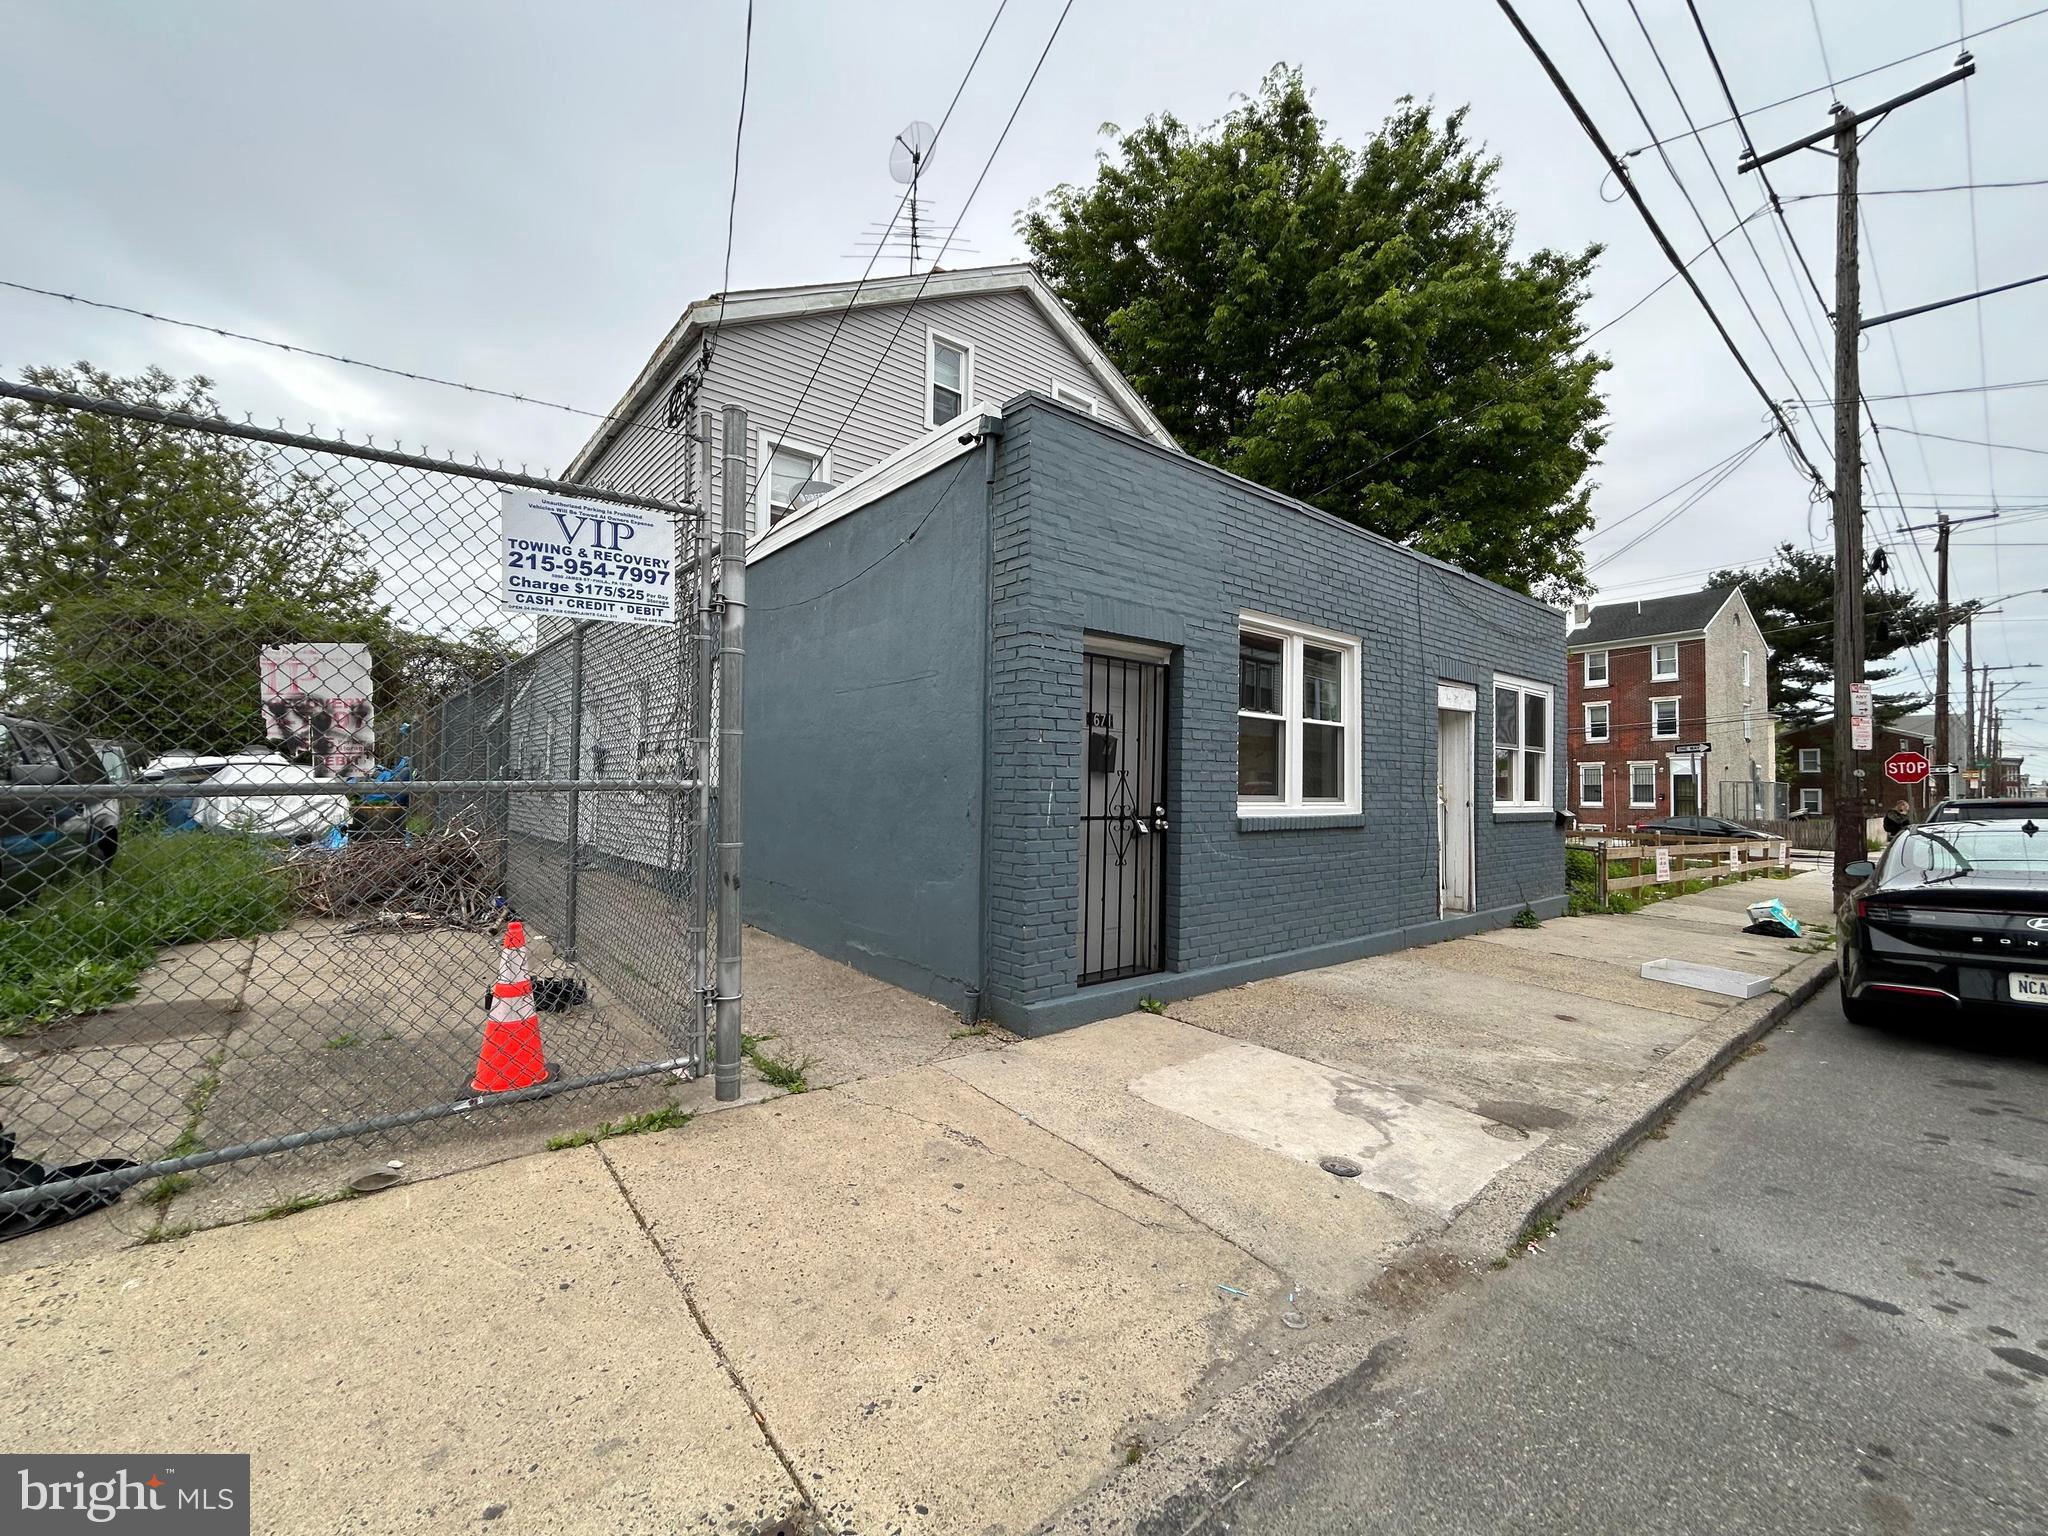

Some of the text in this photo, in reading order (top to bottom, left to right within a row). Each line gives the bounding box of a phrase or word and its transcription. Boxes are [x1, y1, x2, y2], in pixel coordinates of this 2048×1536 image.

[528, 503, 555, 511] Vehicles
[583, 506, 606, 514] Parking
[614, 511, 643, 519] Prohibited
[550, 512, 635, 551] VIP
[508, 538, 670, 569] TOWING & RECOVERY
[508, 551, 670, 586] 215-954-7997
[509, 575, 645, 600] Charge $175/$25
[515, 593, 664, 617] CASH CREDIT DEBIT
[1888, 762, 1927, 774] STOP
